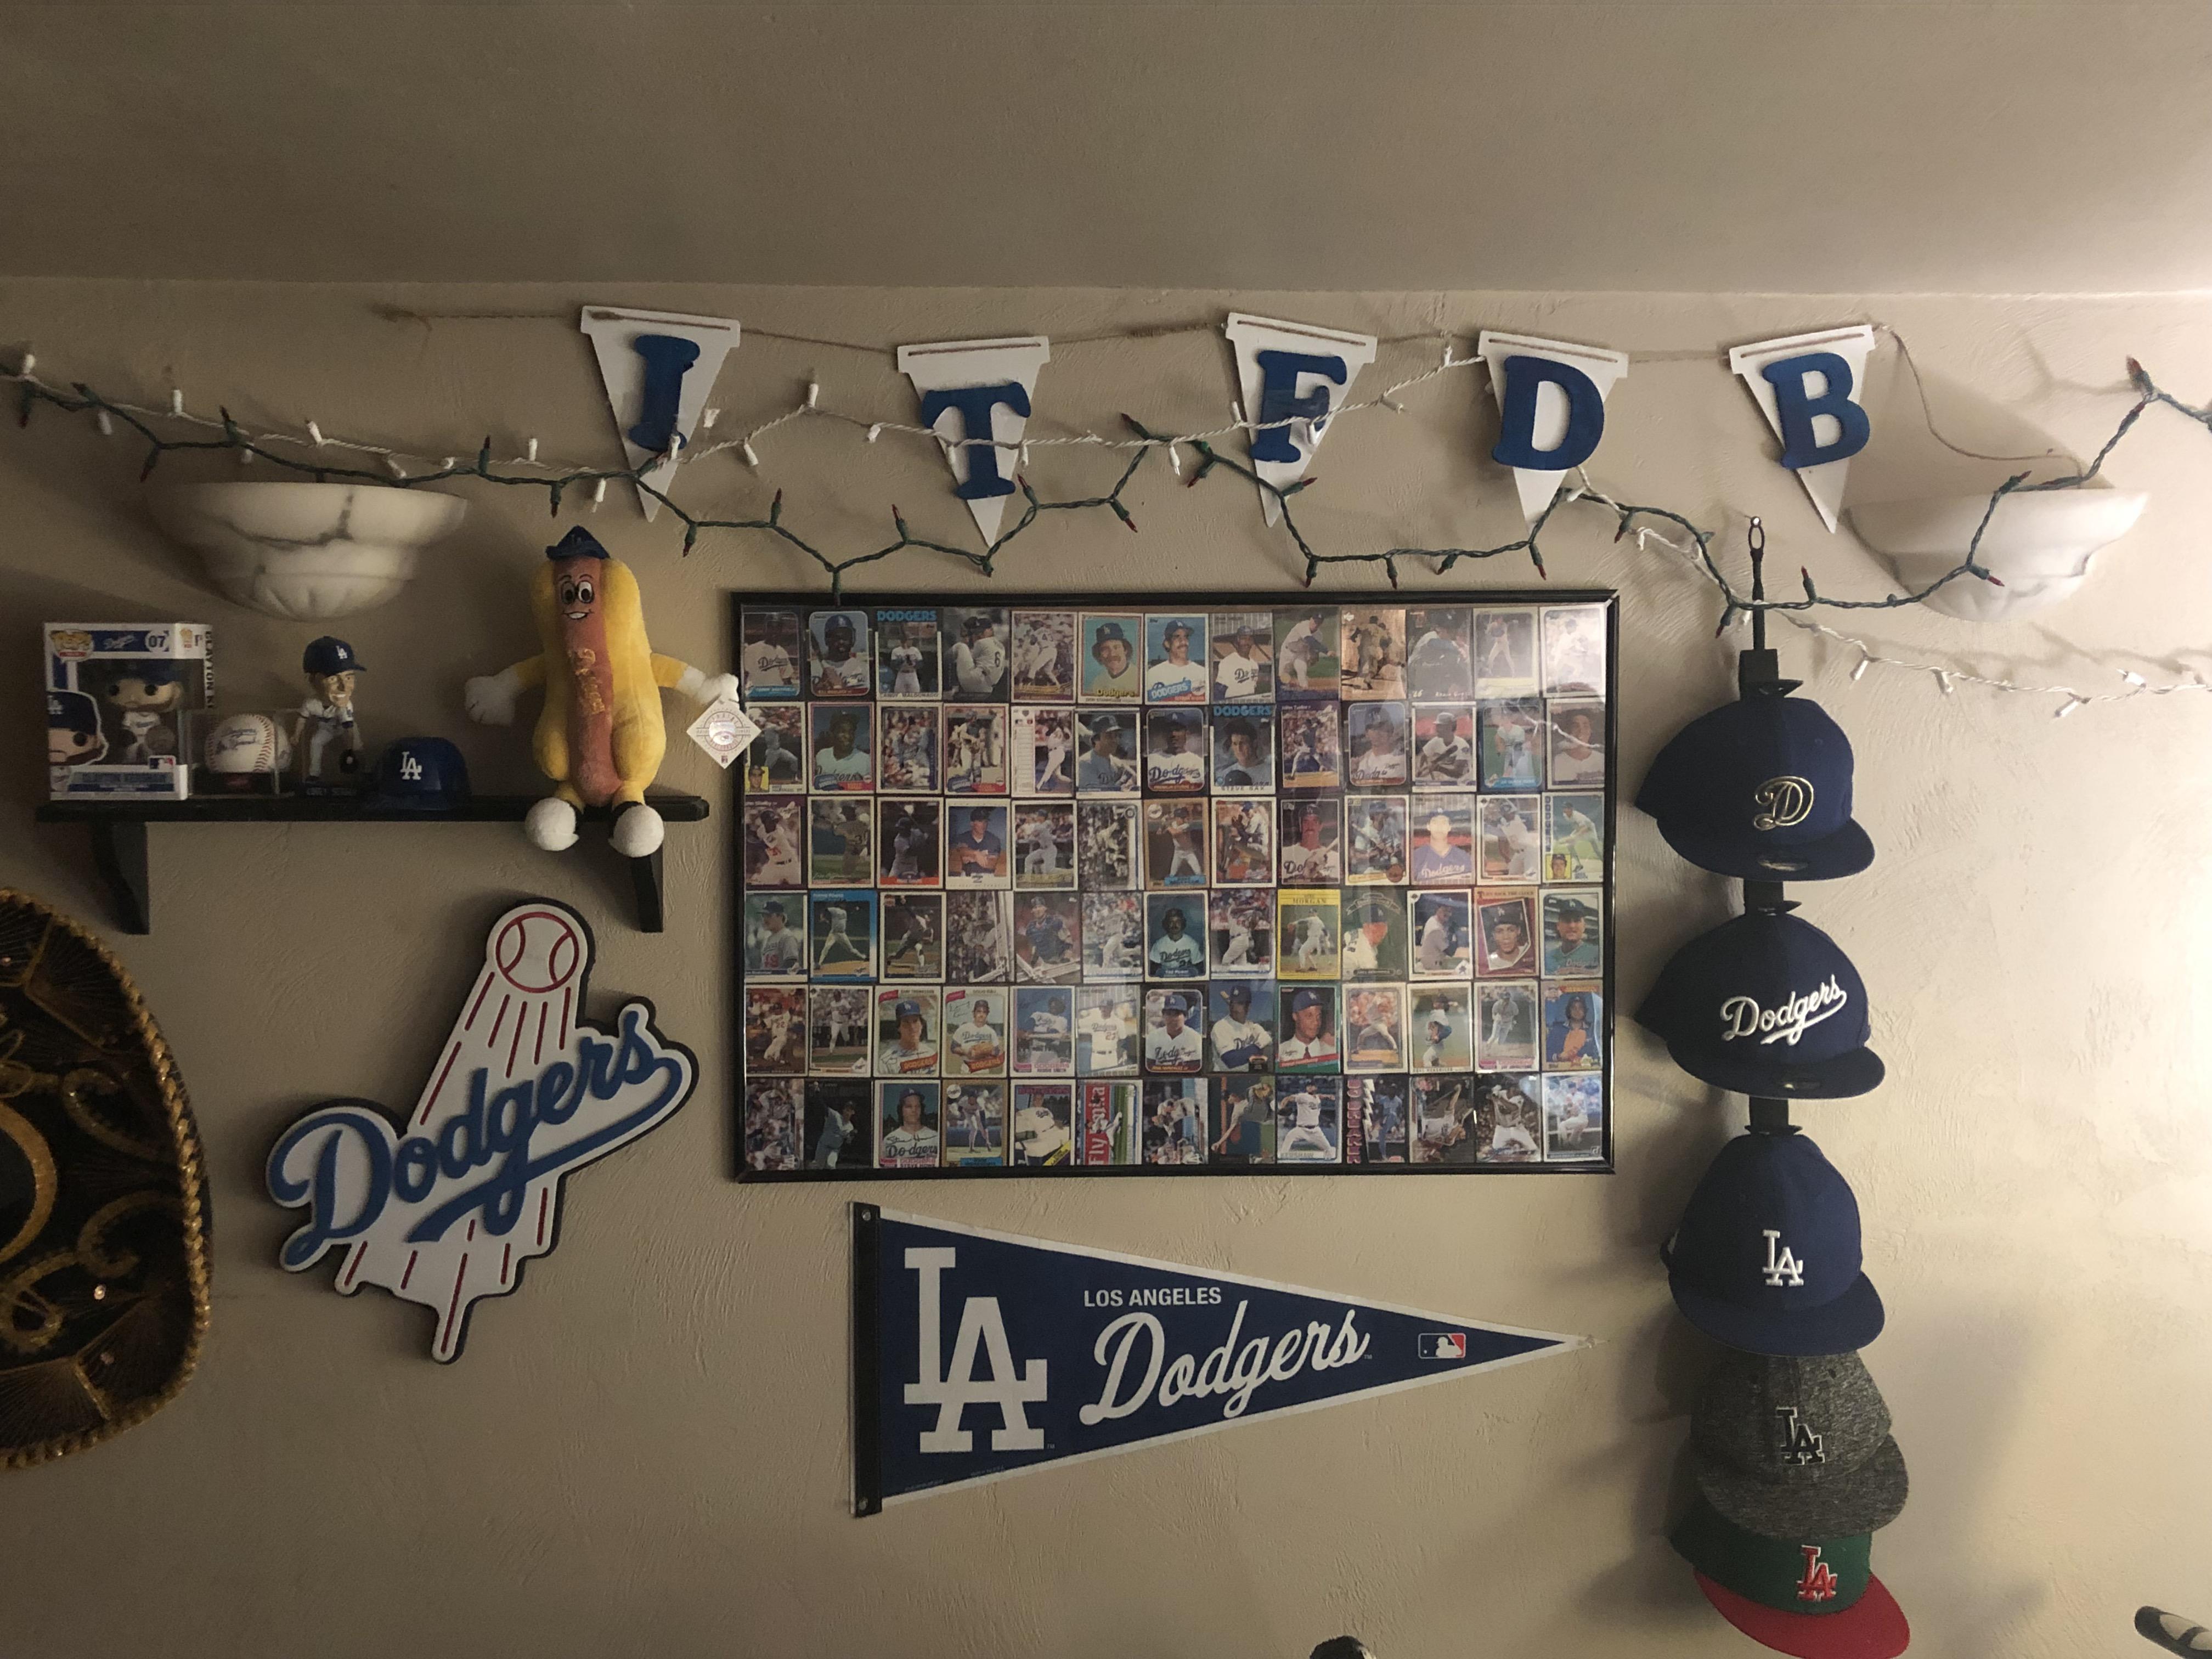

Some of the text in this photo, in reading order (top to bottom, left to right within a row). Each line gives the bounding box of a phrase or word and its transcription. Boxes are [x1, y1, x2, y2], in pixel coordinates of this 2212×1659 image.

[629, 334, 1870, 500] I T F D B
[877, 611, 937, 622] DODGERS
[148, 635, 166, 648] 07
[994, 651, 1001, 668] 6
[1151, 683, 1188, 699] DODGERS
[1214, 705, 1271, 716] DODGERS
[400, 751, 422, 780] LA
[1753, 776, 1814, 831] D
[1421, 863, 1465, 878] Dodgers
[1720, 974, 1847, 1046] Dodgers
[268, 1010, 682, 1266] Dodgers
[885, 1143, 938, 1158] Dodgers
[1762, 1229, 1804, 1286] LA
[1084, 1287, 1221, 1307] LOS ANGELES
[904, 1246, 1047, 1453] LA
[1079, 1300, 1370, 1425] Dodgers
[1775, 1407, 1825, 1465] LA
[1797, 1544, 1838, 1601] LA
